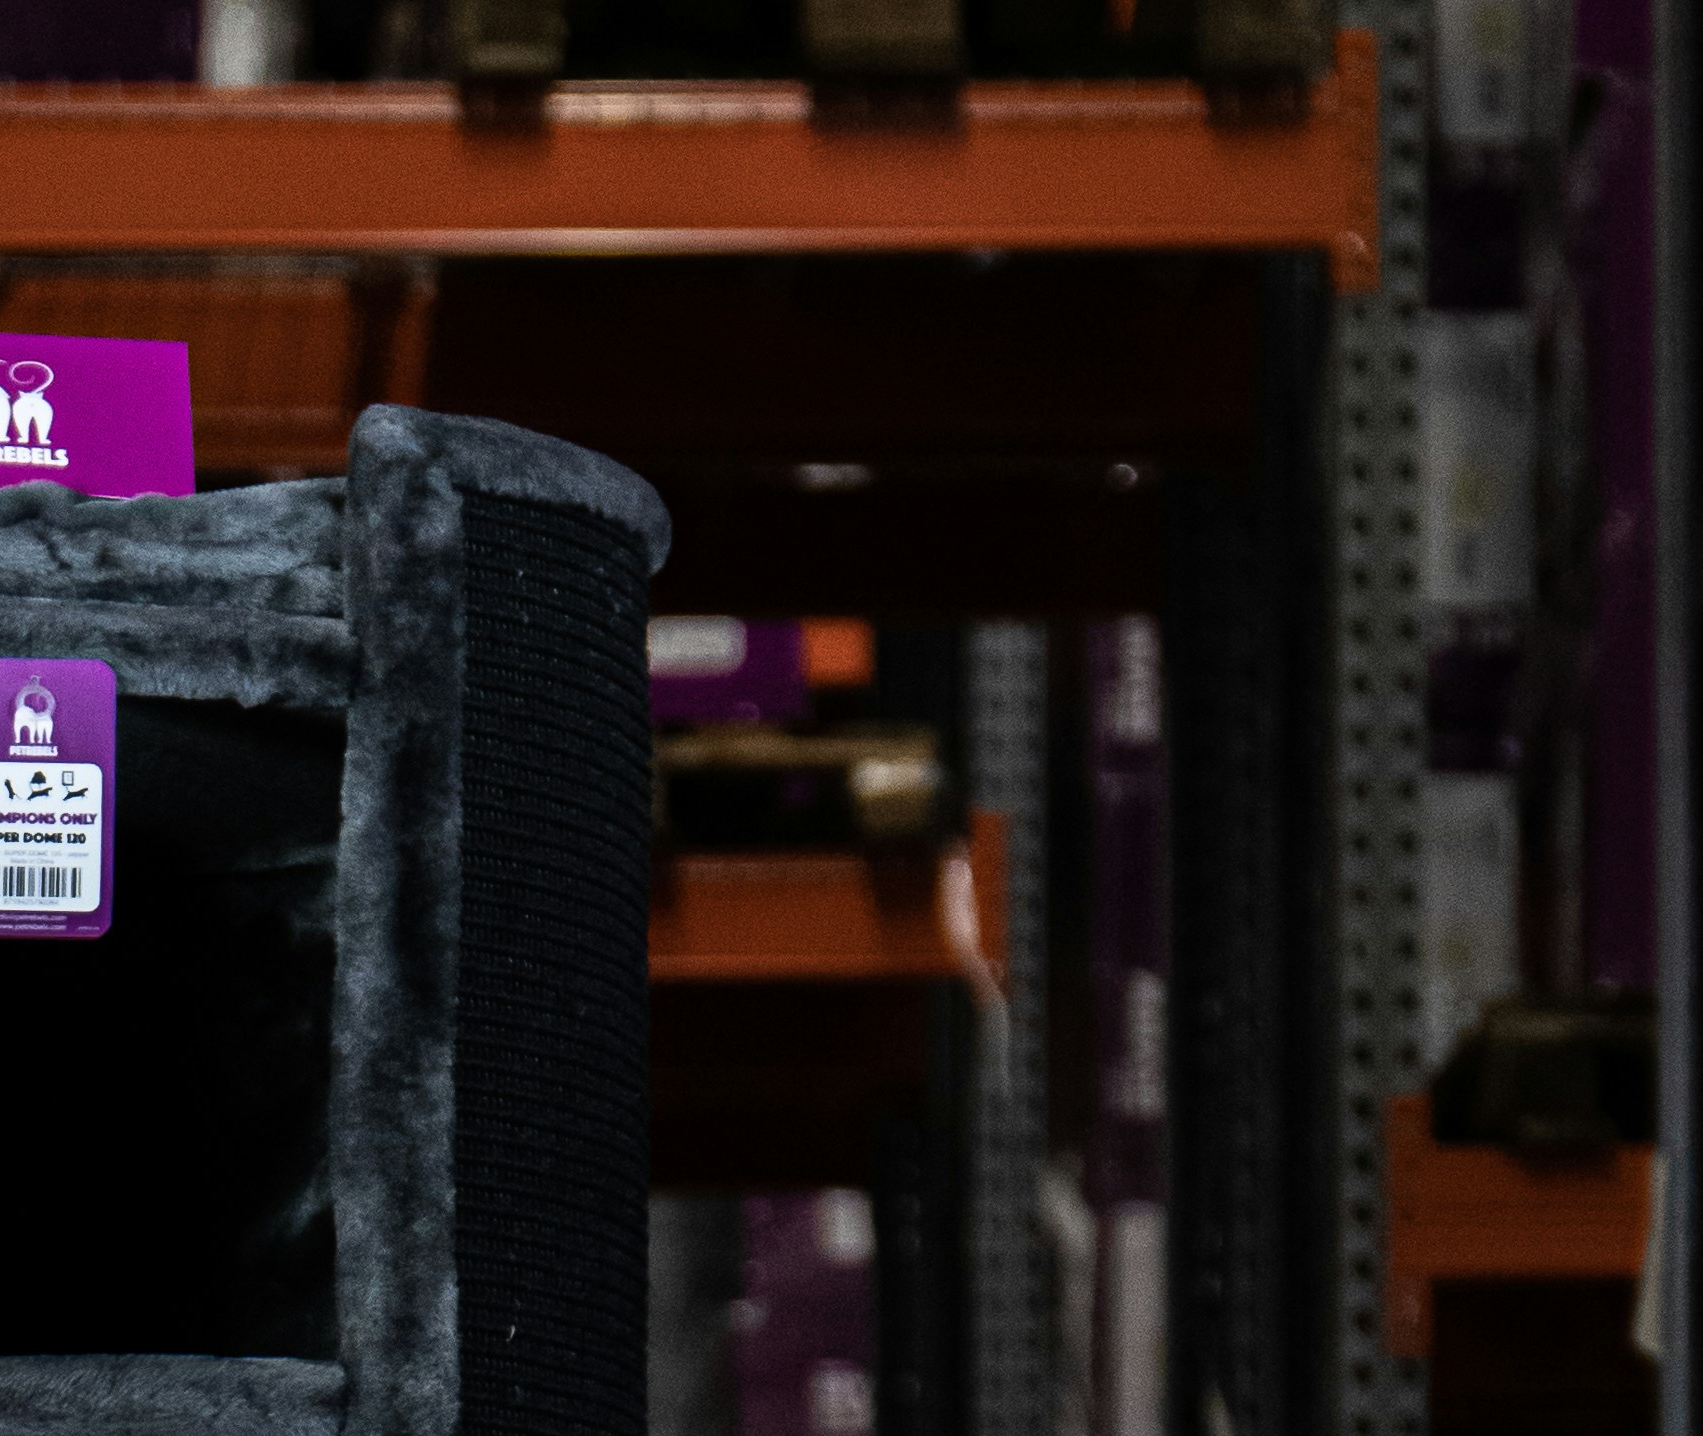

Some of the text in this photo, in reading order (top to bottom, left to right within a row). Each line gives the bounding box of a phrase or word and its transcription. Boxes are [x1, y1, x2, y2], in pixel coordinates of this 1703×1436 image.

[59, 812, 98, 825] ONLY
[23, 832, 63, 844] DOME
[66, 833, 87, 844] 120
